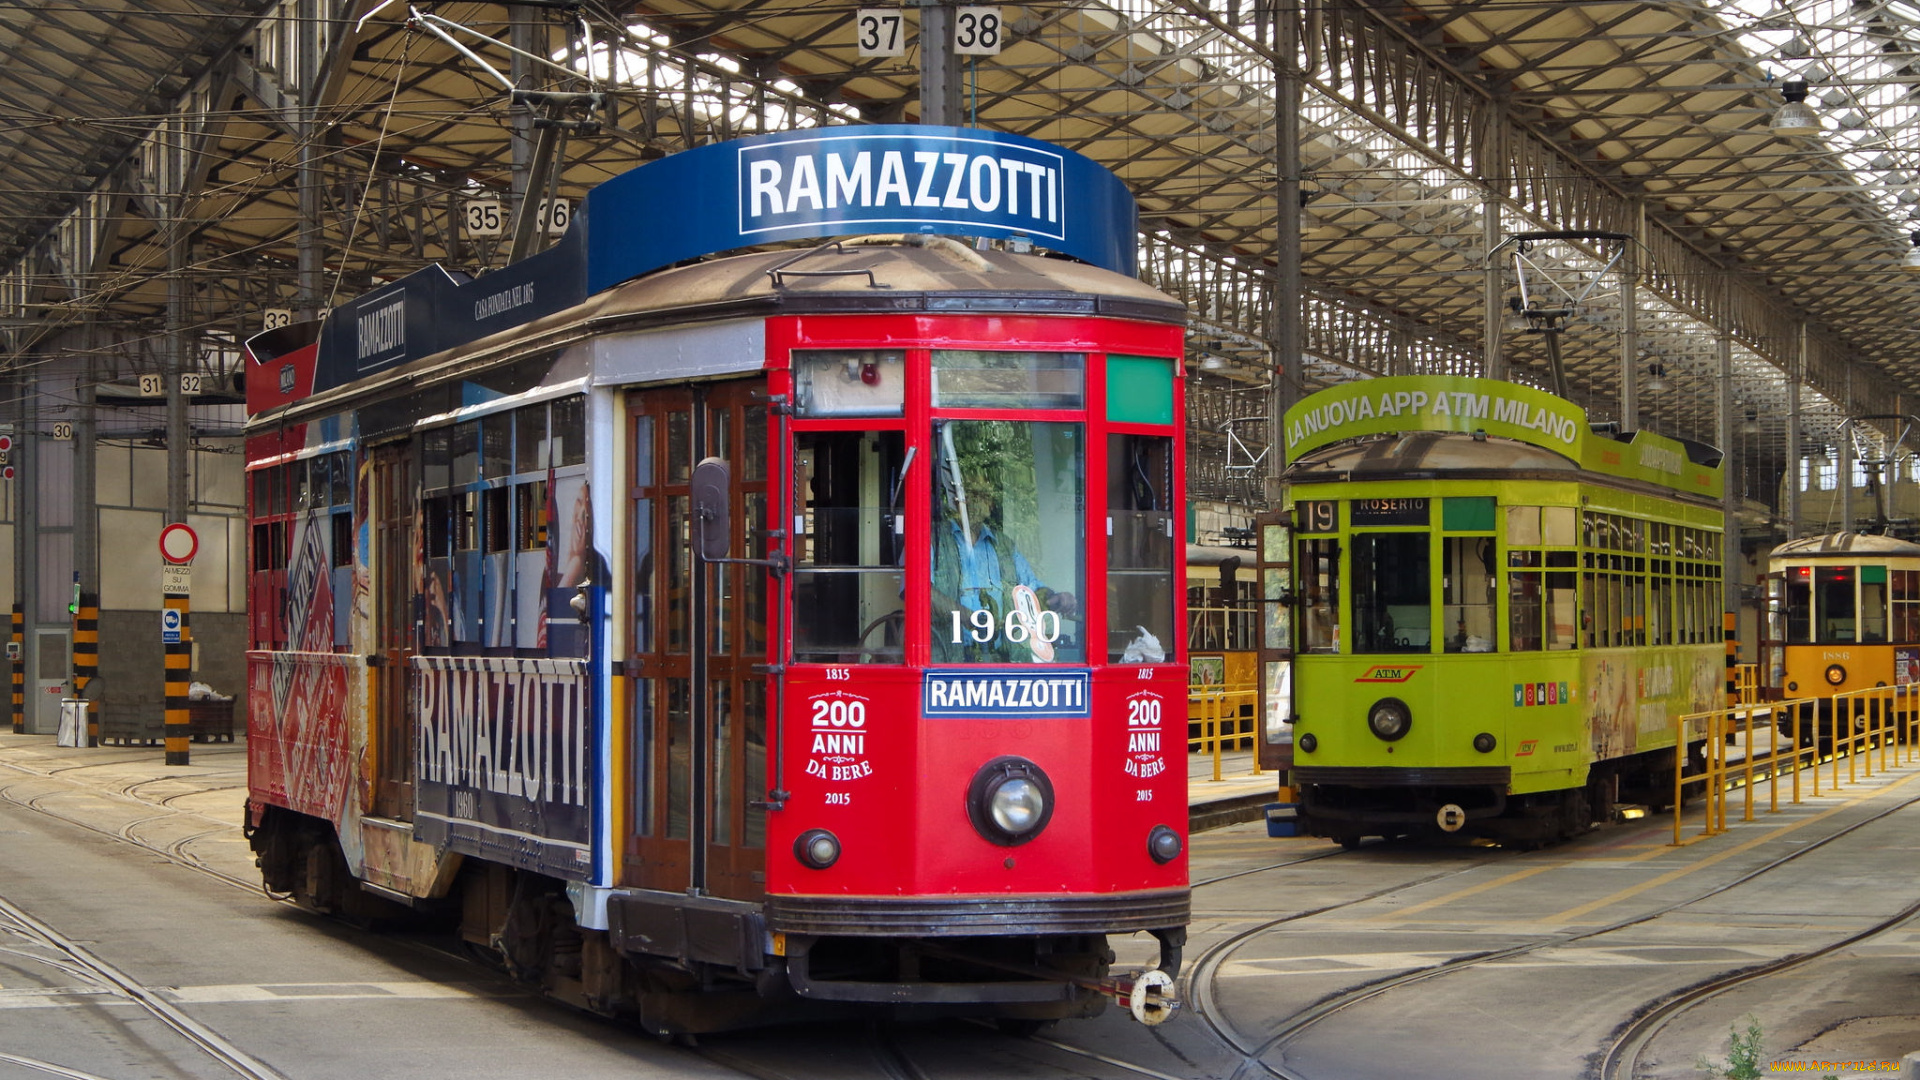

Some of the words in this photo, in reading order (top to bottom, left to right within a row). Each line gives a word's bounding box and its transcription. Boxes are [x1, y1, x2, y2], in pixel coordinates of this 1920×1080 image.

[860, 16, 900, 50] 37
[957, 13, 999, 48] 38
[750, 151, 1057, 223] RAMAZZOTTI
[469, 206, 499, 230] 35
[475, 299, 488, 320] CASA
[488, 289, 511, 316] FONDATA
[511, 285, 523, 308] NEL
[523, 281, 534, 304] 1815
[358, 300, 404, 359] RAMAZZOTTI
[143, 378, 159, 393] 31
[182, 376, 200, 391] 32
[1287, 419, 1305, 448] LA
[1304, 395, 1375, 437] NUOVA
[1378, 391, 1428, 417] APP
[1432, 391, 1489, 419] ATM
[1493, 397, 1576, 444] MILANO
[55, 424, 71, 438] 30
[1360, 499, 1424, 510] ROSERIO
[1308, 501, 1333, 531] 19
[171, 567, 190, 575] MEZZI
[951, 609, 1060, 644] 1960
[1823, 651, 1850, 661] 1886
[826, 668, 850, 680] 1815
[1138, 668, 1154, 680] 1815
[1375, 669, 1402, 679] ATM
[931, 680, 1082, 707] RAMAZZOTTI
[812, 700, 865, 727] 200
[1128, 700, 1161, 726] 200
[418, 658, 585, 807] RAMAZZOTTI
[1128, 733, 1160, 752] ANNI
[812, 734, 864, 754] ANNI
[805, 759, 828, 780] DA
[832, 760, 873, 781] BERE
[1124, 758, 1138, 777] DA
[1140, 757, 1166, 778] BERE
[455, 791, 473, 819] 1960
[825, 793, 851, 805] 2015
[1136, 789, 1153, 801] 2015
